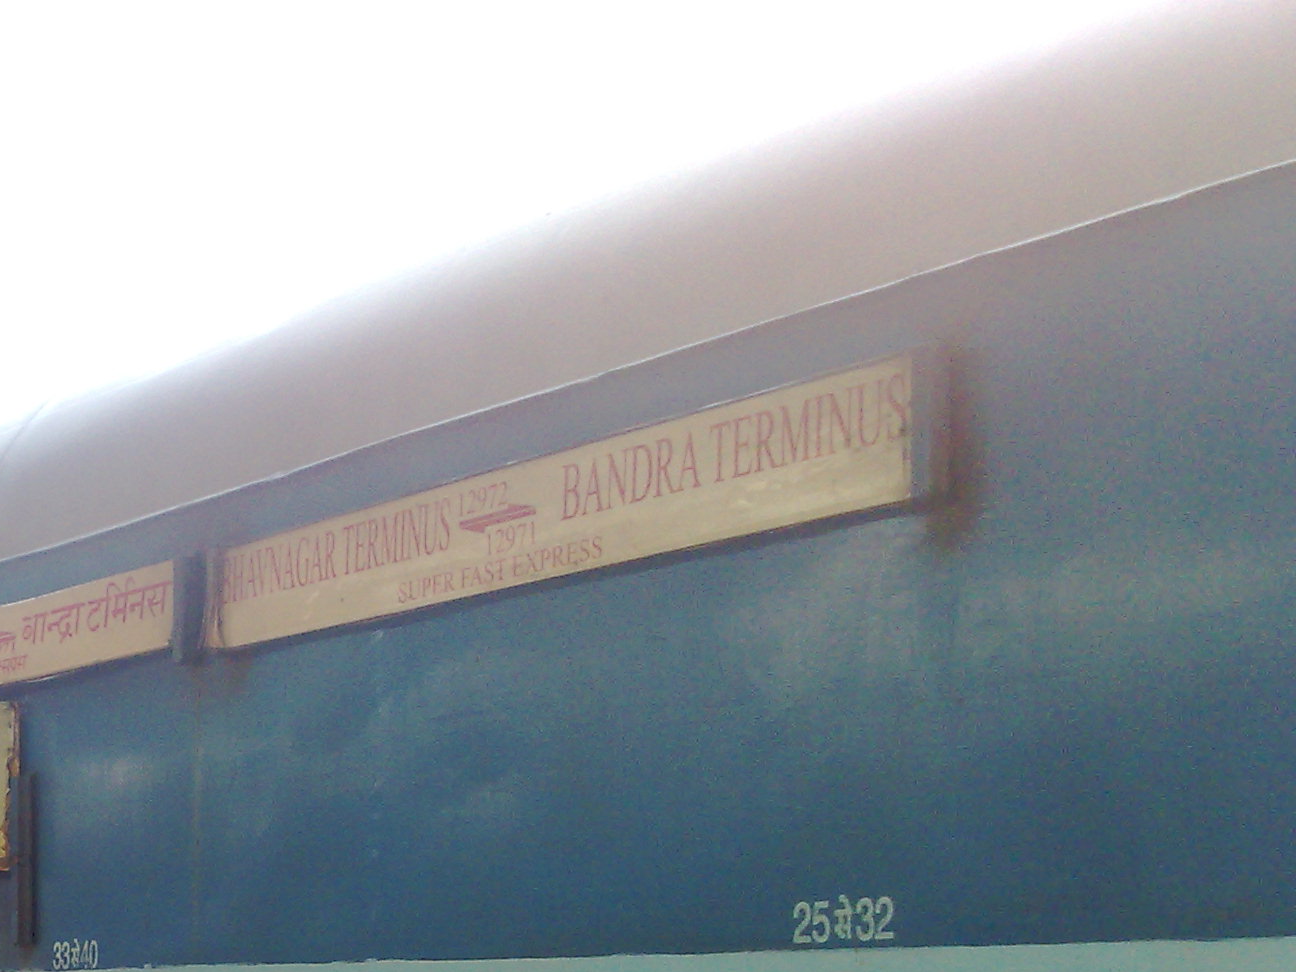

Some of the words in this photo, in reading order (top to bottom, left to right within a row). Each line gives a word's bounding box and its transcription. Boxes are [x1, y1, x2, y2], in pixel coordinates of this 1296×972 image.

[561, 432, 701, 520] BANDRA
[711, 373, 912, 483] TERMINUS
[343, 497, 451, 576] TERMINUS
[398, 572, 454, 604] SUPER
[461, 557, 506, 589] FAST
[512, 536, 603, 577] EXPRESS
[487, 521, 536, 556] 12971
